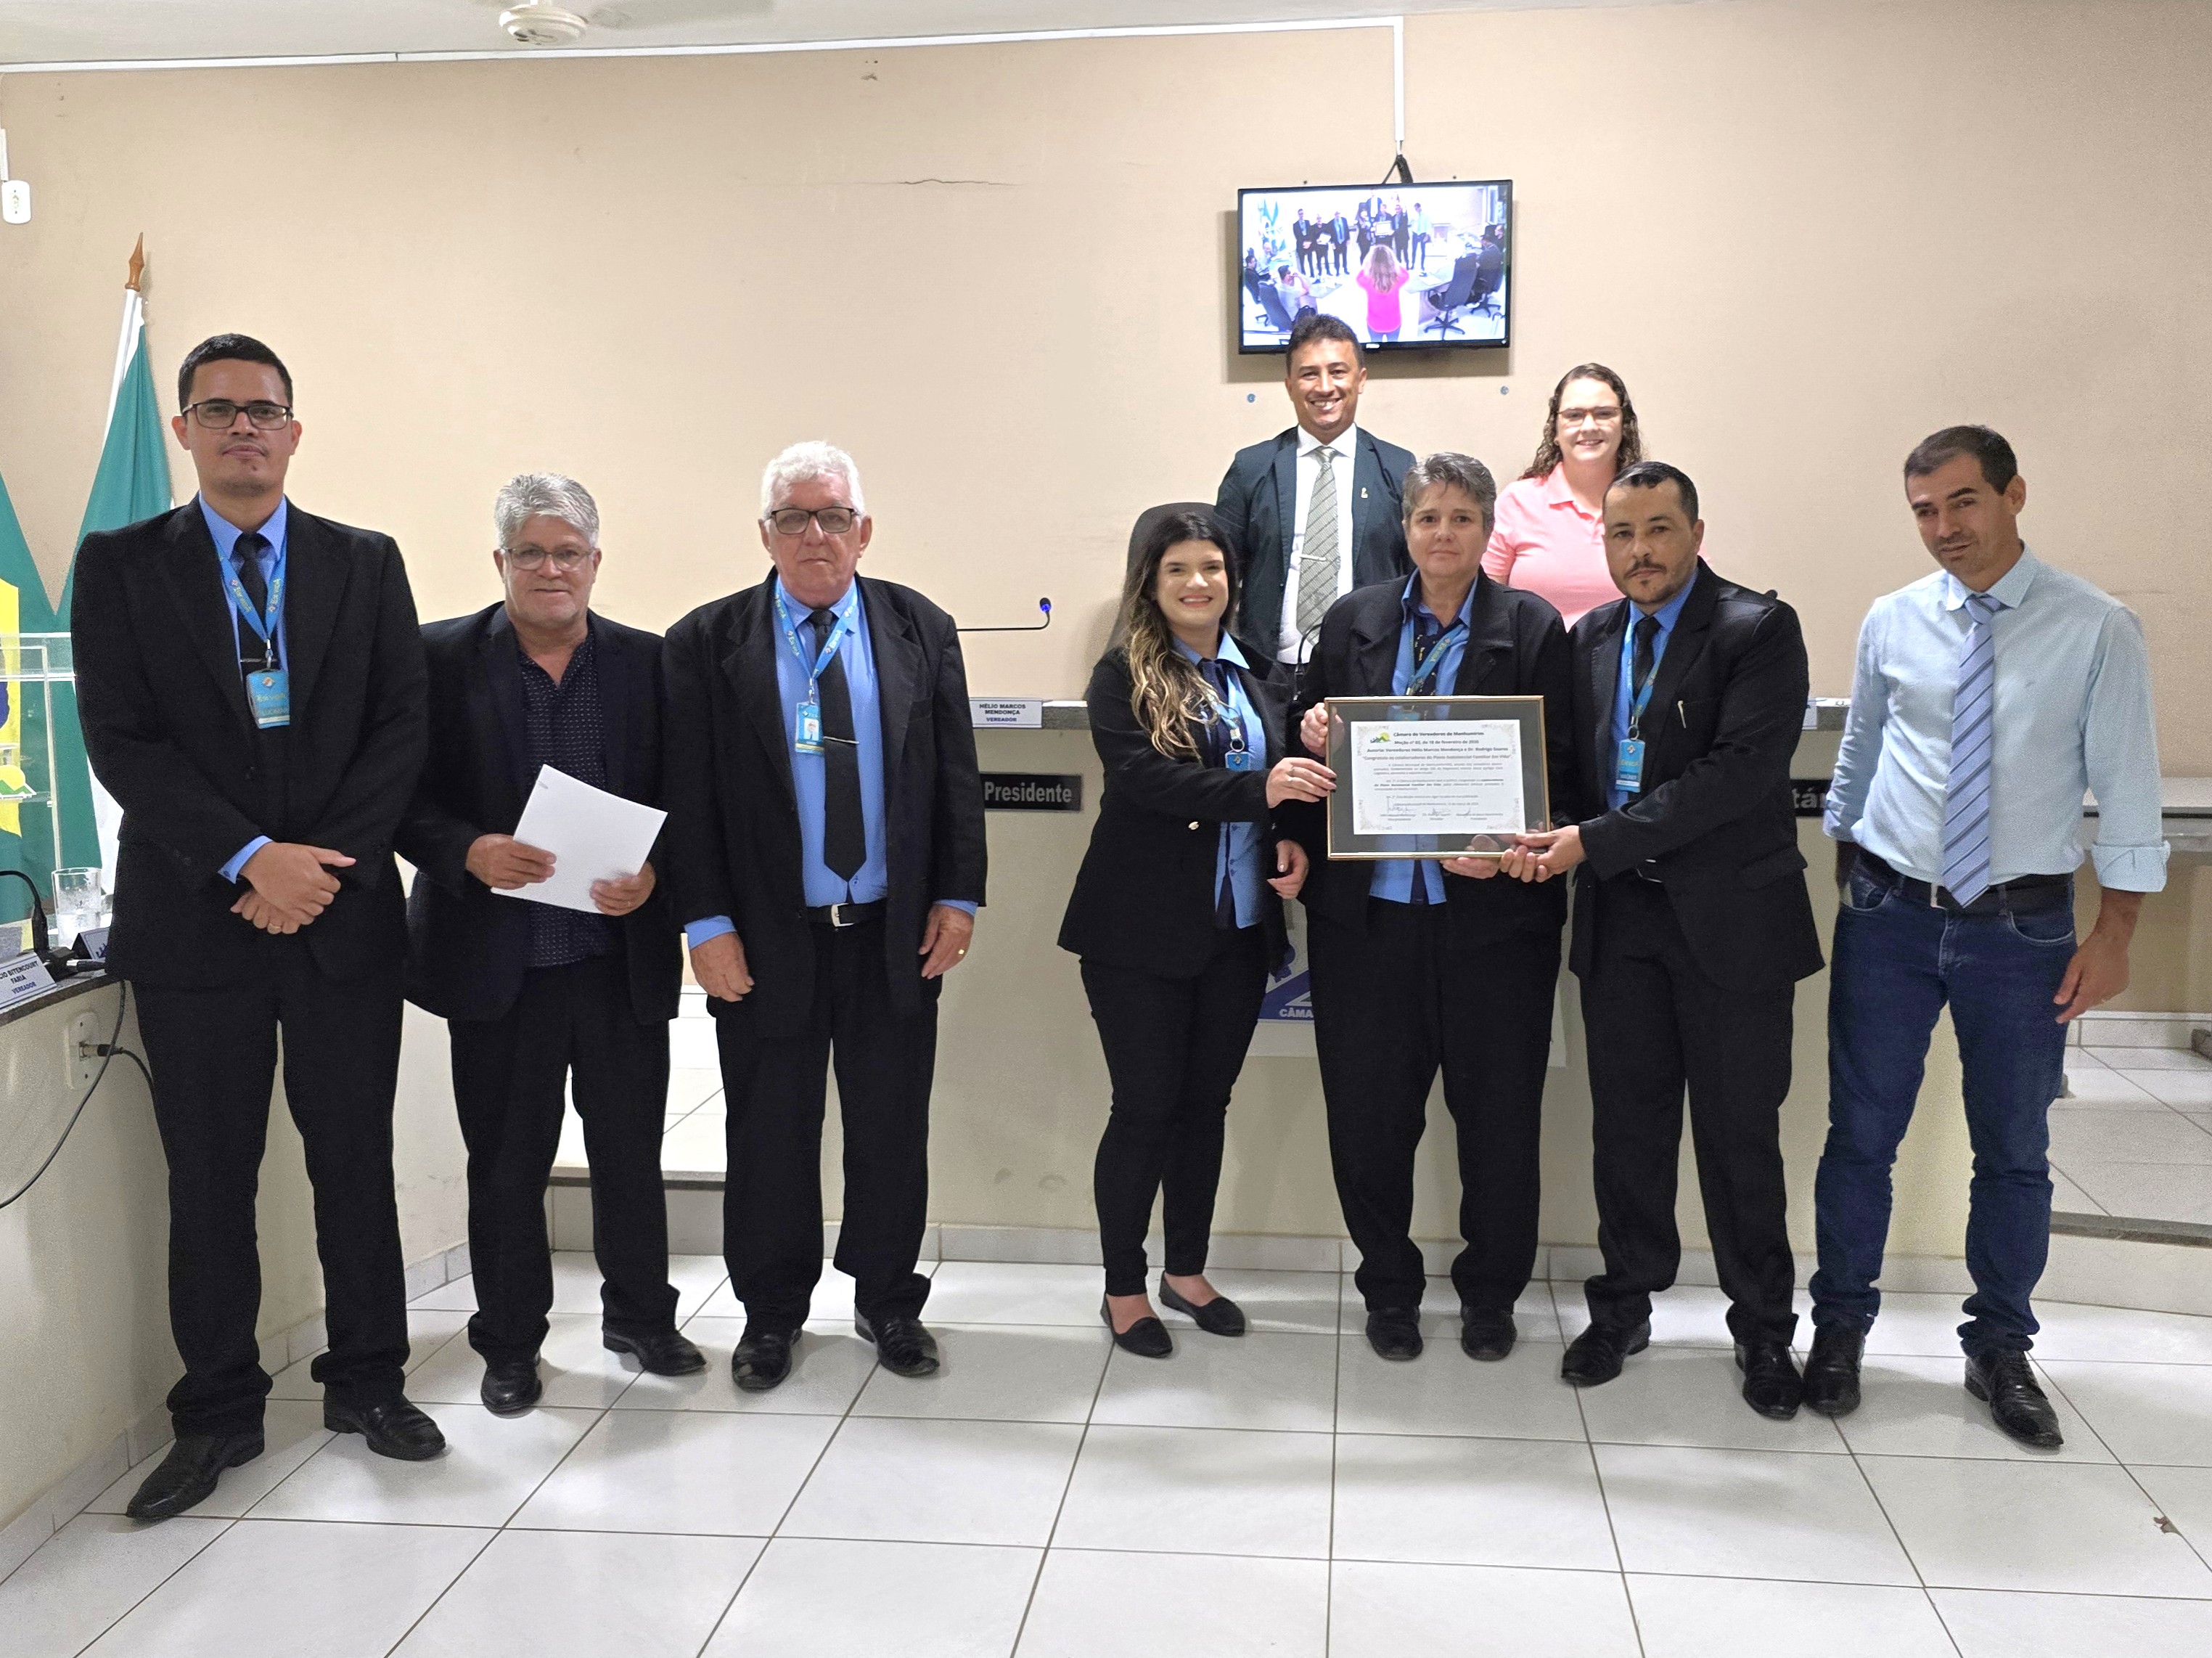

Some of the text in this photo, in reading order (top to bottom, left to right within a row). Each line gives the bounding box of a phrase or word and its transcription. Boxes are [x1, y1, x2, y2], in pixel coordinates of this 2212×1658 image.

[984, 781, 1072, 803] Presidente
[7, 960, 39, 976] BITENCOURT
[10, 974, 27, 984] FARIA
[12, 981, 37, 995] VEREADOR
